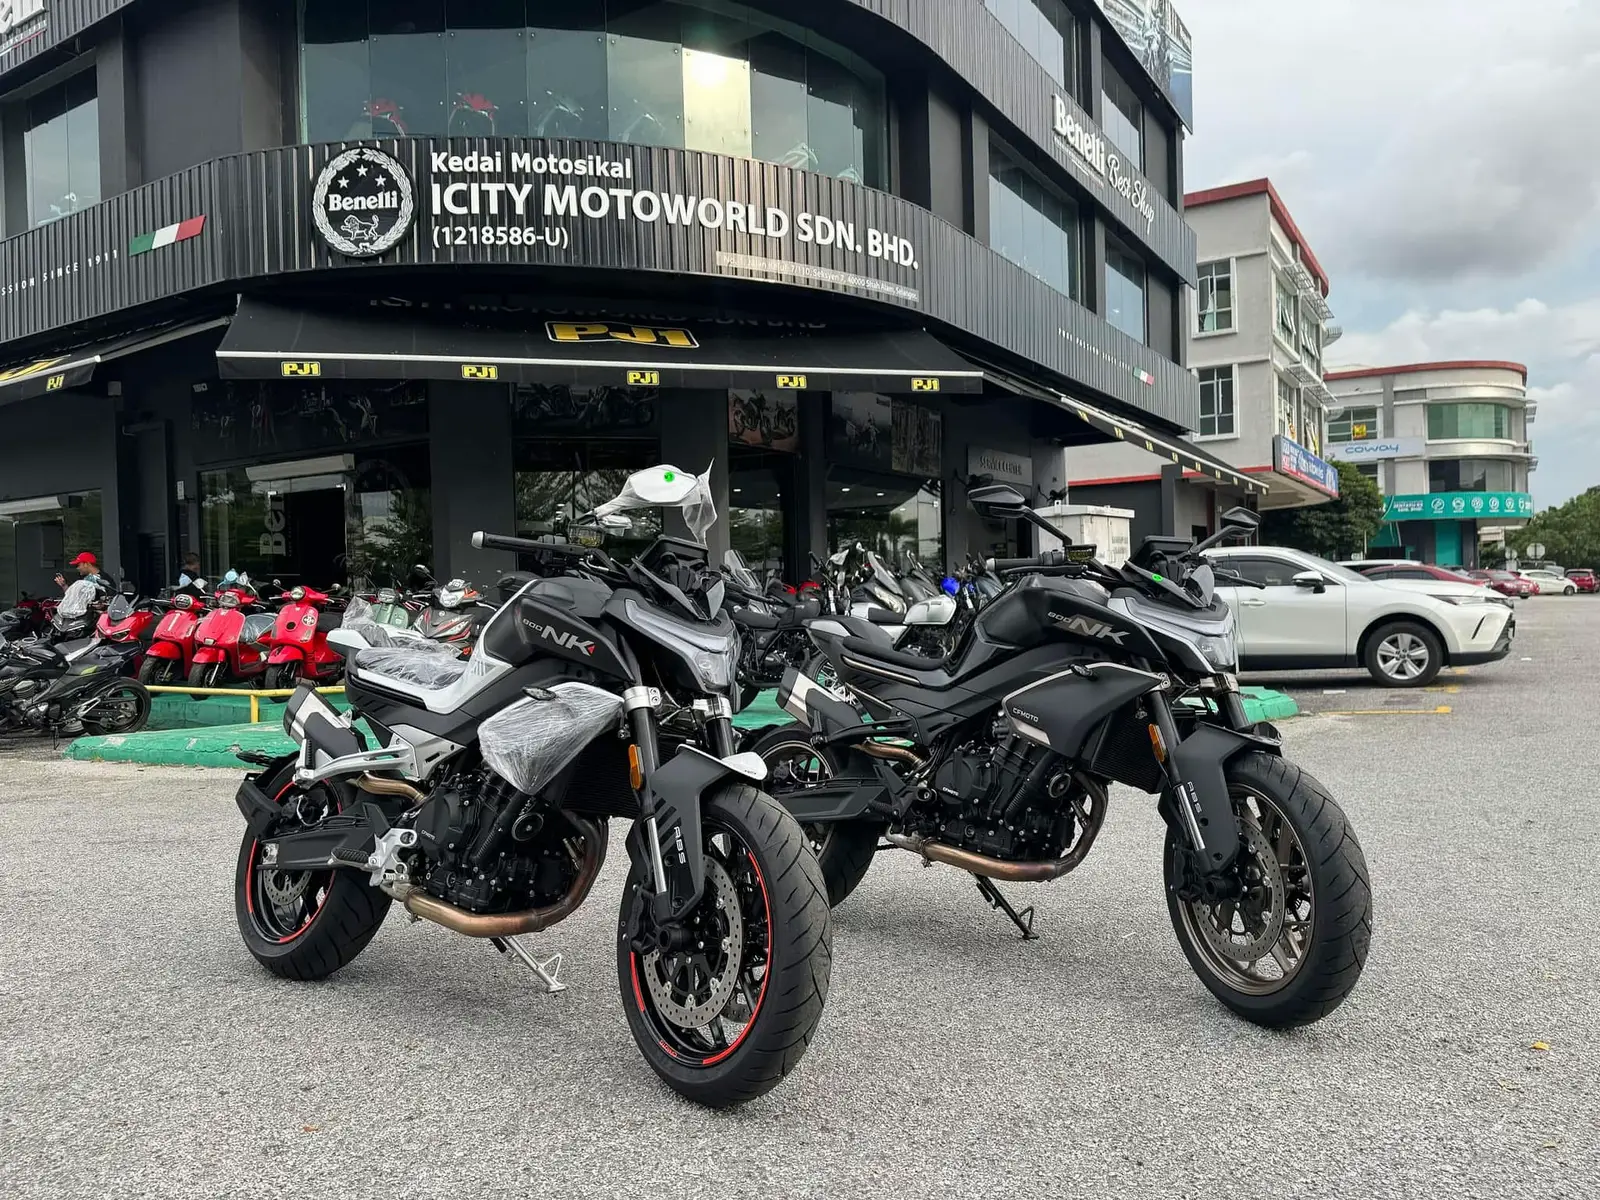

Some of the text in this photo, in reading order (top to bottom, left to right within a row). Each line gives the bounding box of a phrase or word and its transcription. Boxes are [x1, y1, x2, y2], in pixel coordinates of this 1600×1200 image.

[1053, 92, 1105, 177] Benelli
[431, 151, 631, 179] Kedai Motosikal
[328, 190, 399, 212] Benelli
[1107, 153, 1155, 236] Best Shop
[432, 182, 919, 270] ICITY MOTOWORLD SDN. BHD.
[432, 225, 569, 250] (1218586-U)
[42, 261, 79, 282] SINCE
[88, 249, 118, 267] 1911
[551, 320, 694, 347] PJ1
[282, 361, 320, 377] PJ1
[463, 365, 497, 379] PJ1
[628, 371, 659, 385] PJ1
[47, 374, 64, 390] PJ1
[777, 375, 807, 389] PJ1
[912, 378, 938, 392] PJ1
[541, 625, 595, 657] NK
[1069, 617, 1131, 646] NK
[1012, 707, 1039, 722] CFMOTO
